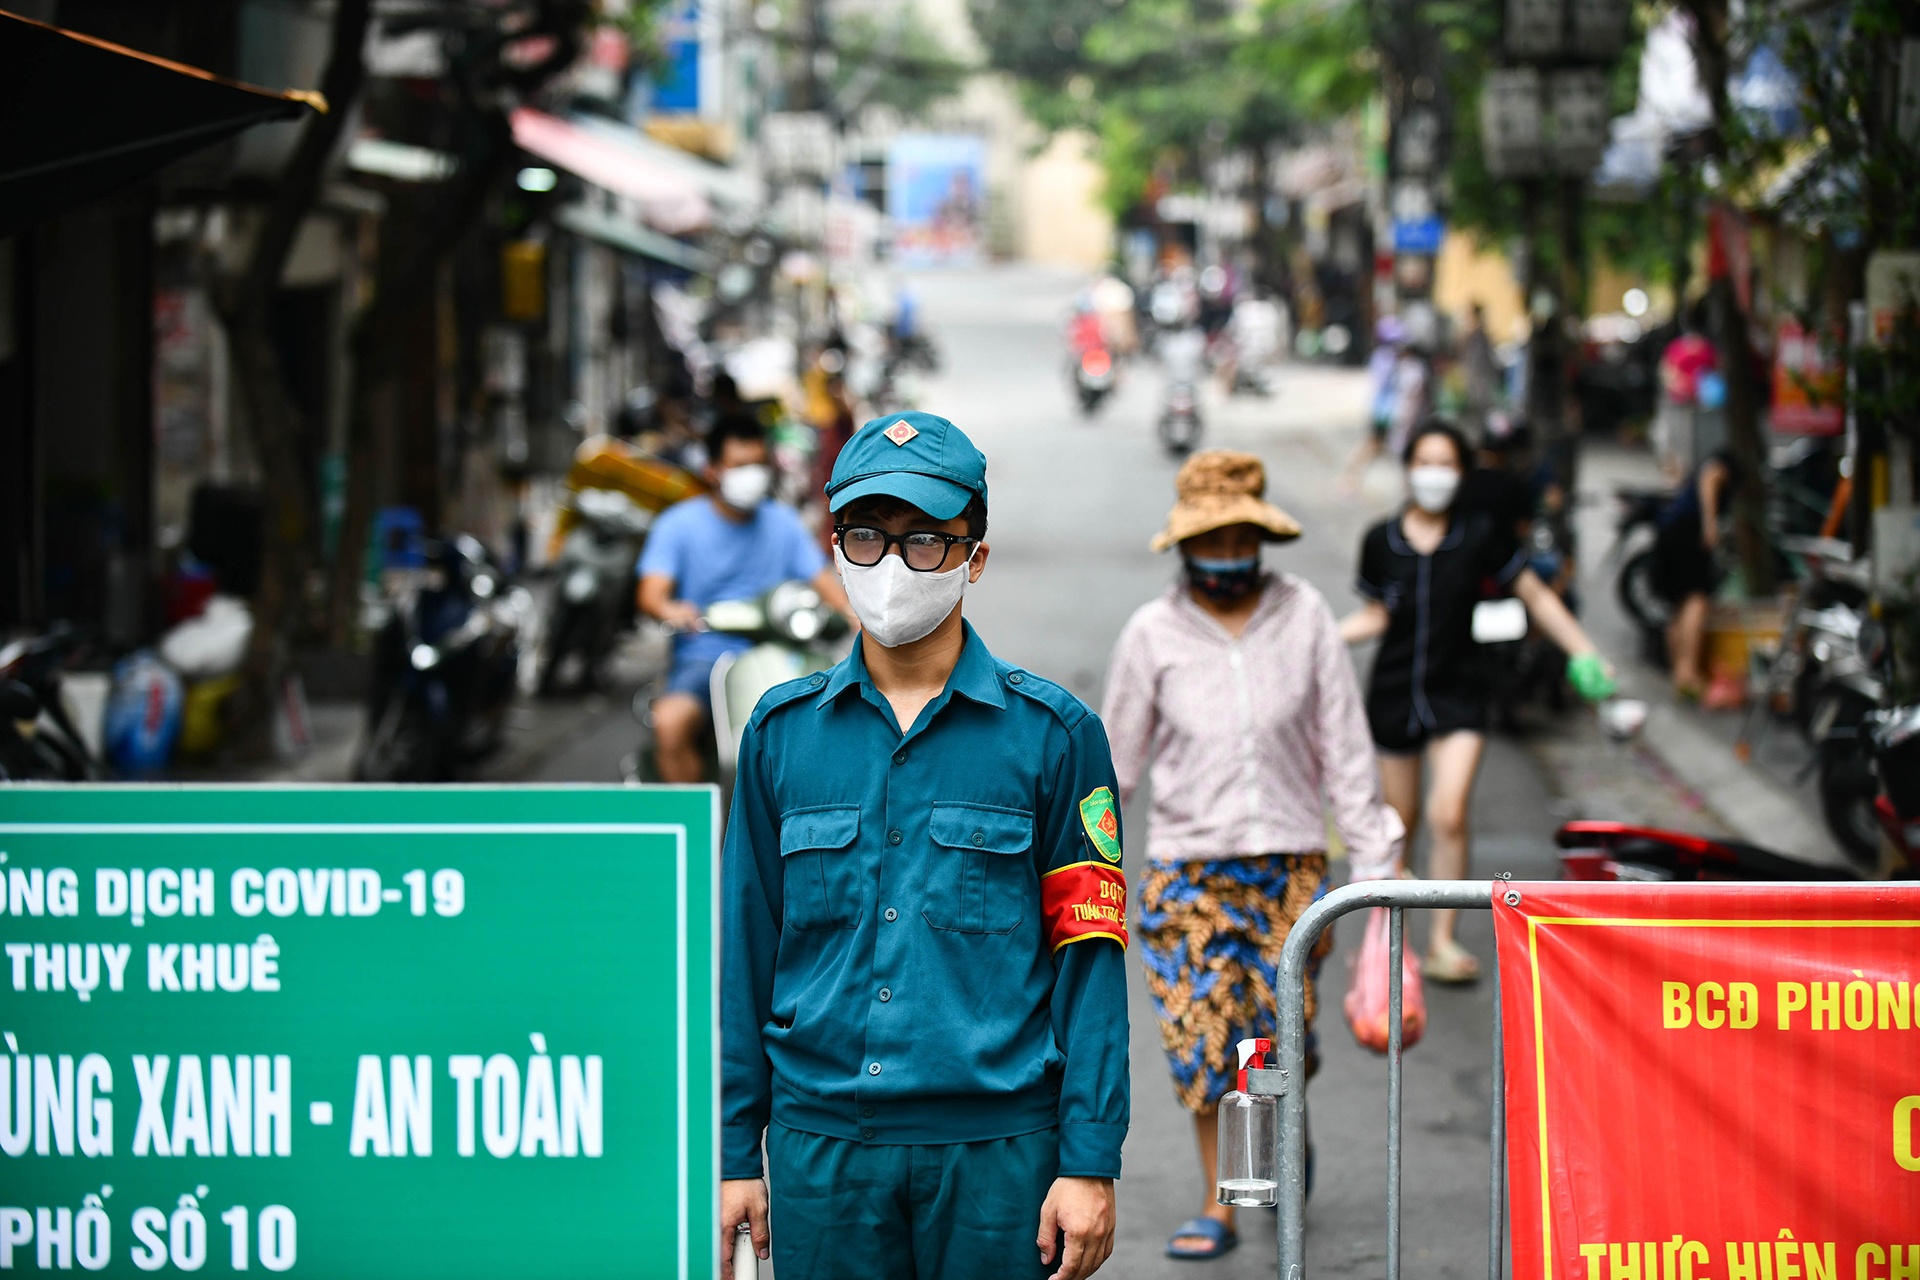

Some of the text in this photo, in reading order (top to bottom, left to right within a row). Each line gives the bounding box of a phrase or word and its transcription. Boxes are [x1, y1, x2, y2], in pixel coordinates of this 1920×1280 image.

[0, 853, 465, 927] NG DỊCH COVID-19
[6, 933, 281, 1002] THỤY KHUÊ
[1662, 969, 1920, 1031] BCĐ PHÒN
[133, 1055, 292, 1158] XANH
[310, 1102, 333, 1125] -
[350, 1055, 433, 1158] AN
[449, 1033, 603, 1158] TOÀN
[0, 1185, 297, 1272] PHỐ SỐ 10
